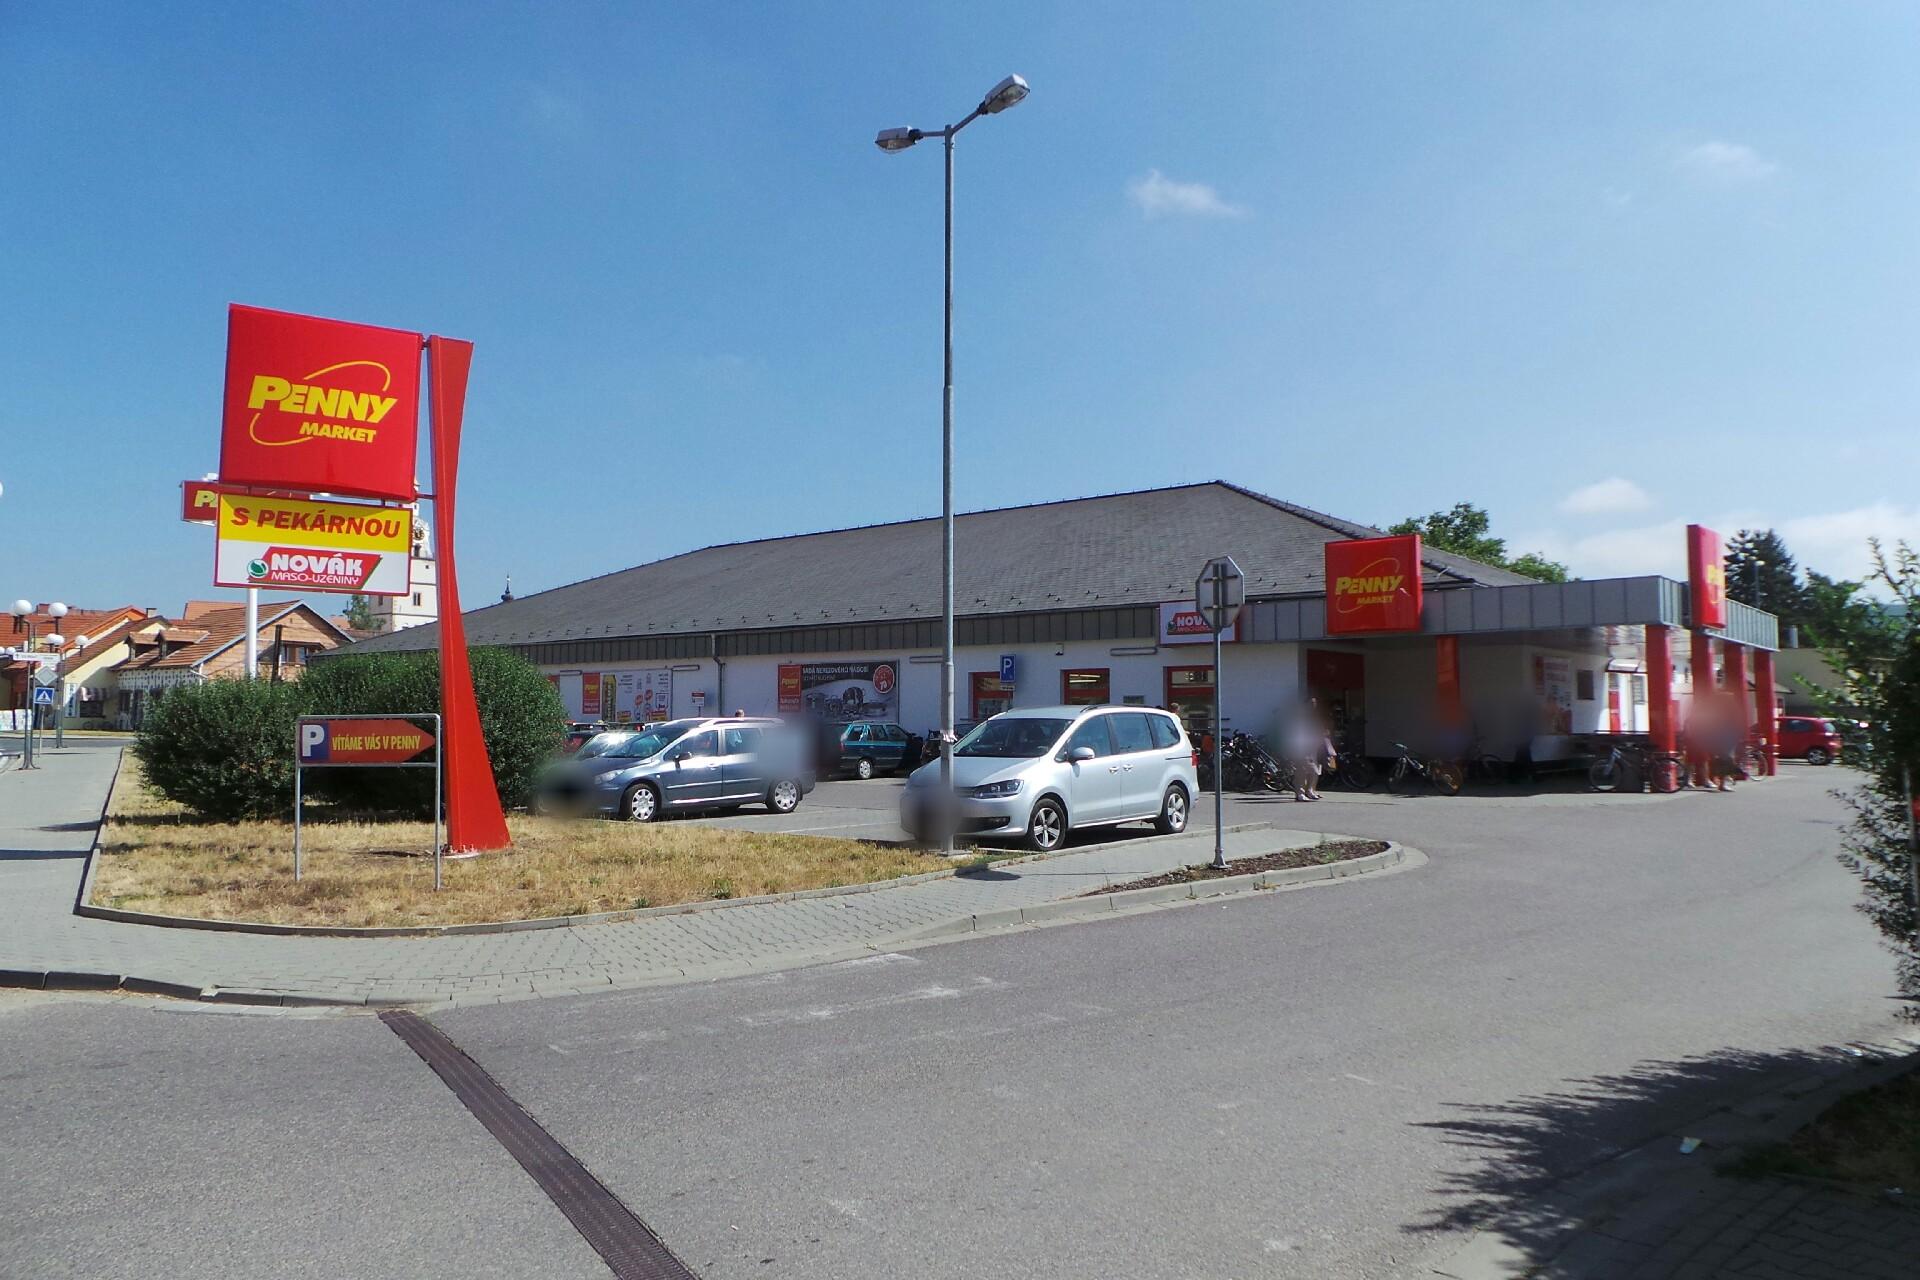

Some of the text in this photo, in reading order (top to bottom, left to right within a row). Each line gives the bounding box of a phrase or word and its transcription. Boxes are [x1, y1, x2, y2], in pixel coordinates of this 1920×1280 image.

[248, 375, 397, 423] PENNY
[299, 421, 377, 443] MARKET
[231, 507, 401, 538] S PEKÁRNOU
[271, 553, 363, 576] NOVÁK
[271, 571, 360, 585] MASO-UZENINY
[1336, 575, 1404, 595] PENNY
[1177, 615, 1208, 627] NOV
[1003, 658, 1013, 674] P
[302, 725, 325, 756] P
[332, 733, 421, 750] VÍTÁME VÁS V PENNY
